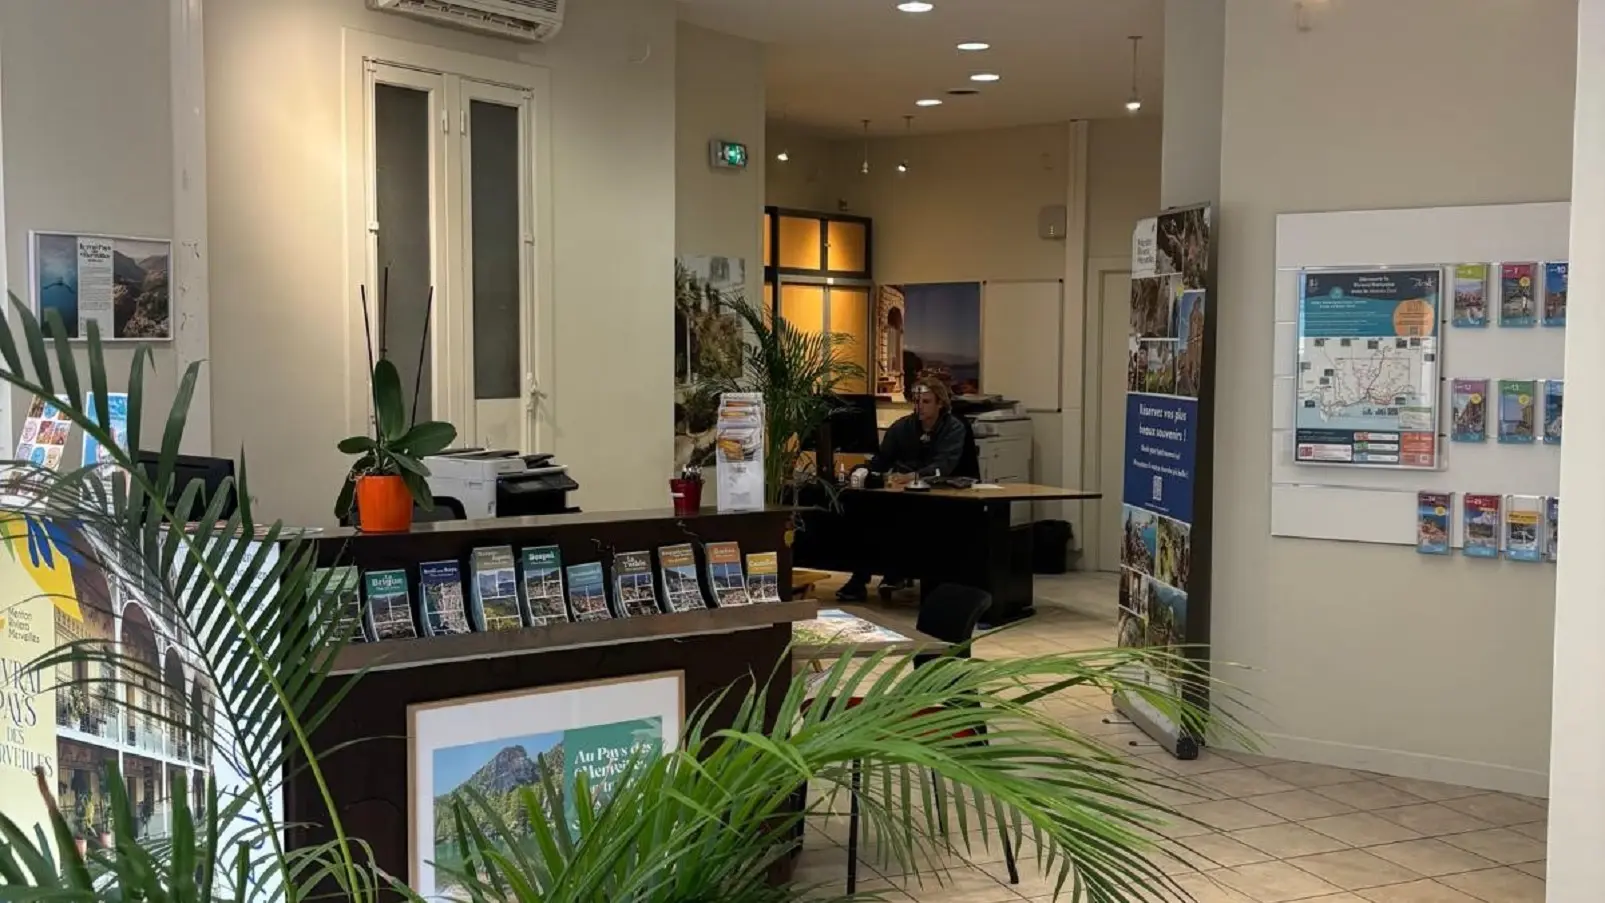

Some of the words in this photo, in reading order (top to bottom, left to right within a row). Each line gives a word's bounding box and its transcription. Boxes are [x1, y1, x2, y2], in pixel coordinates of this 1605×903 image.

[1140, 403, 1163, 418] Réservez
[1164, 410, 1174, 420] vos
[1174, 408, 1187, 424] plus
[1140, 422, 1155, 437] beaux
[1156, 427, 1182, 442] souvenirs
[371, 578, 403, 587] Brigue
[8, 607, 33, 620] Menton
[8, 620, 30, 631] Riviera
[8, 629, 41, 643] Merveilles
[7, 726, 25, 745] DES
[574, 751, 595, 765] Au
[597, 747, 628, 761] Pays
